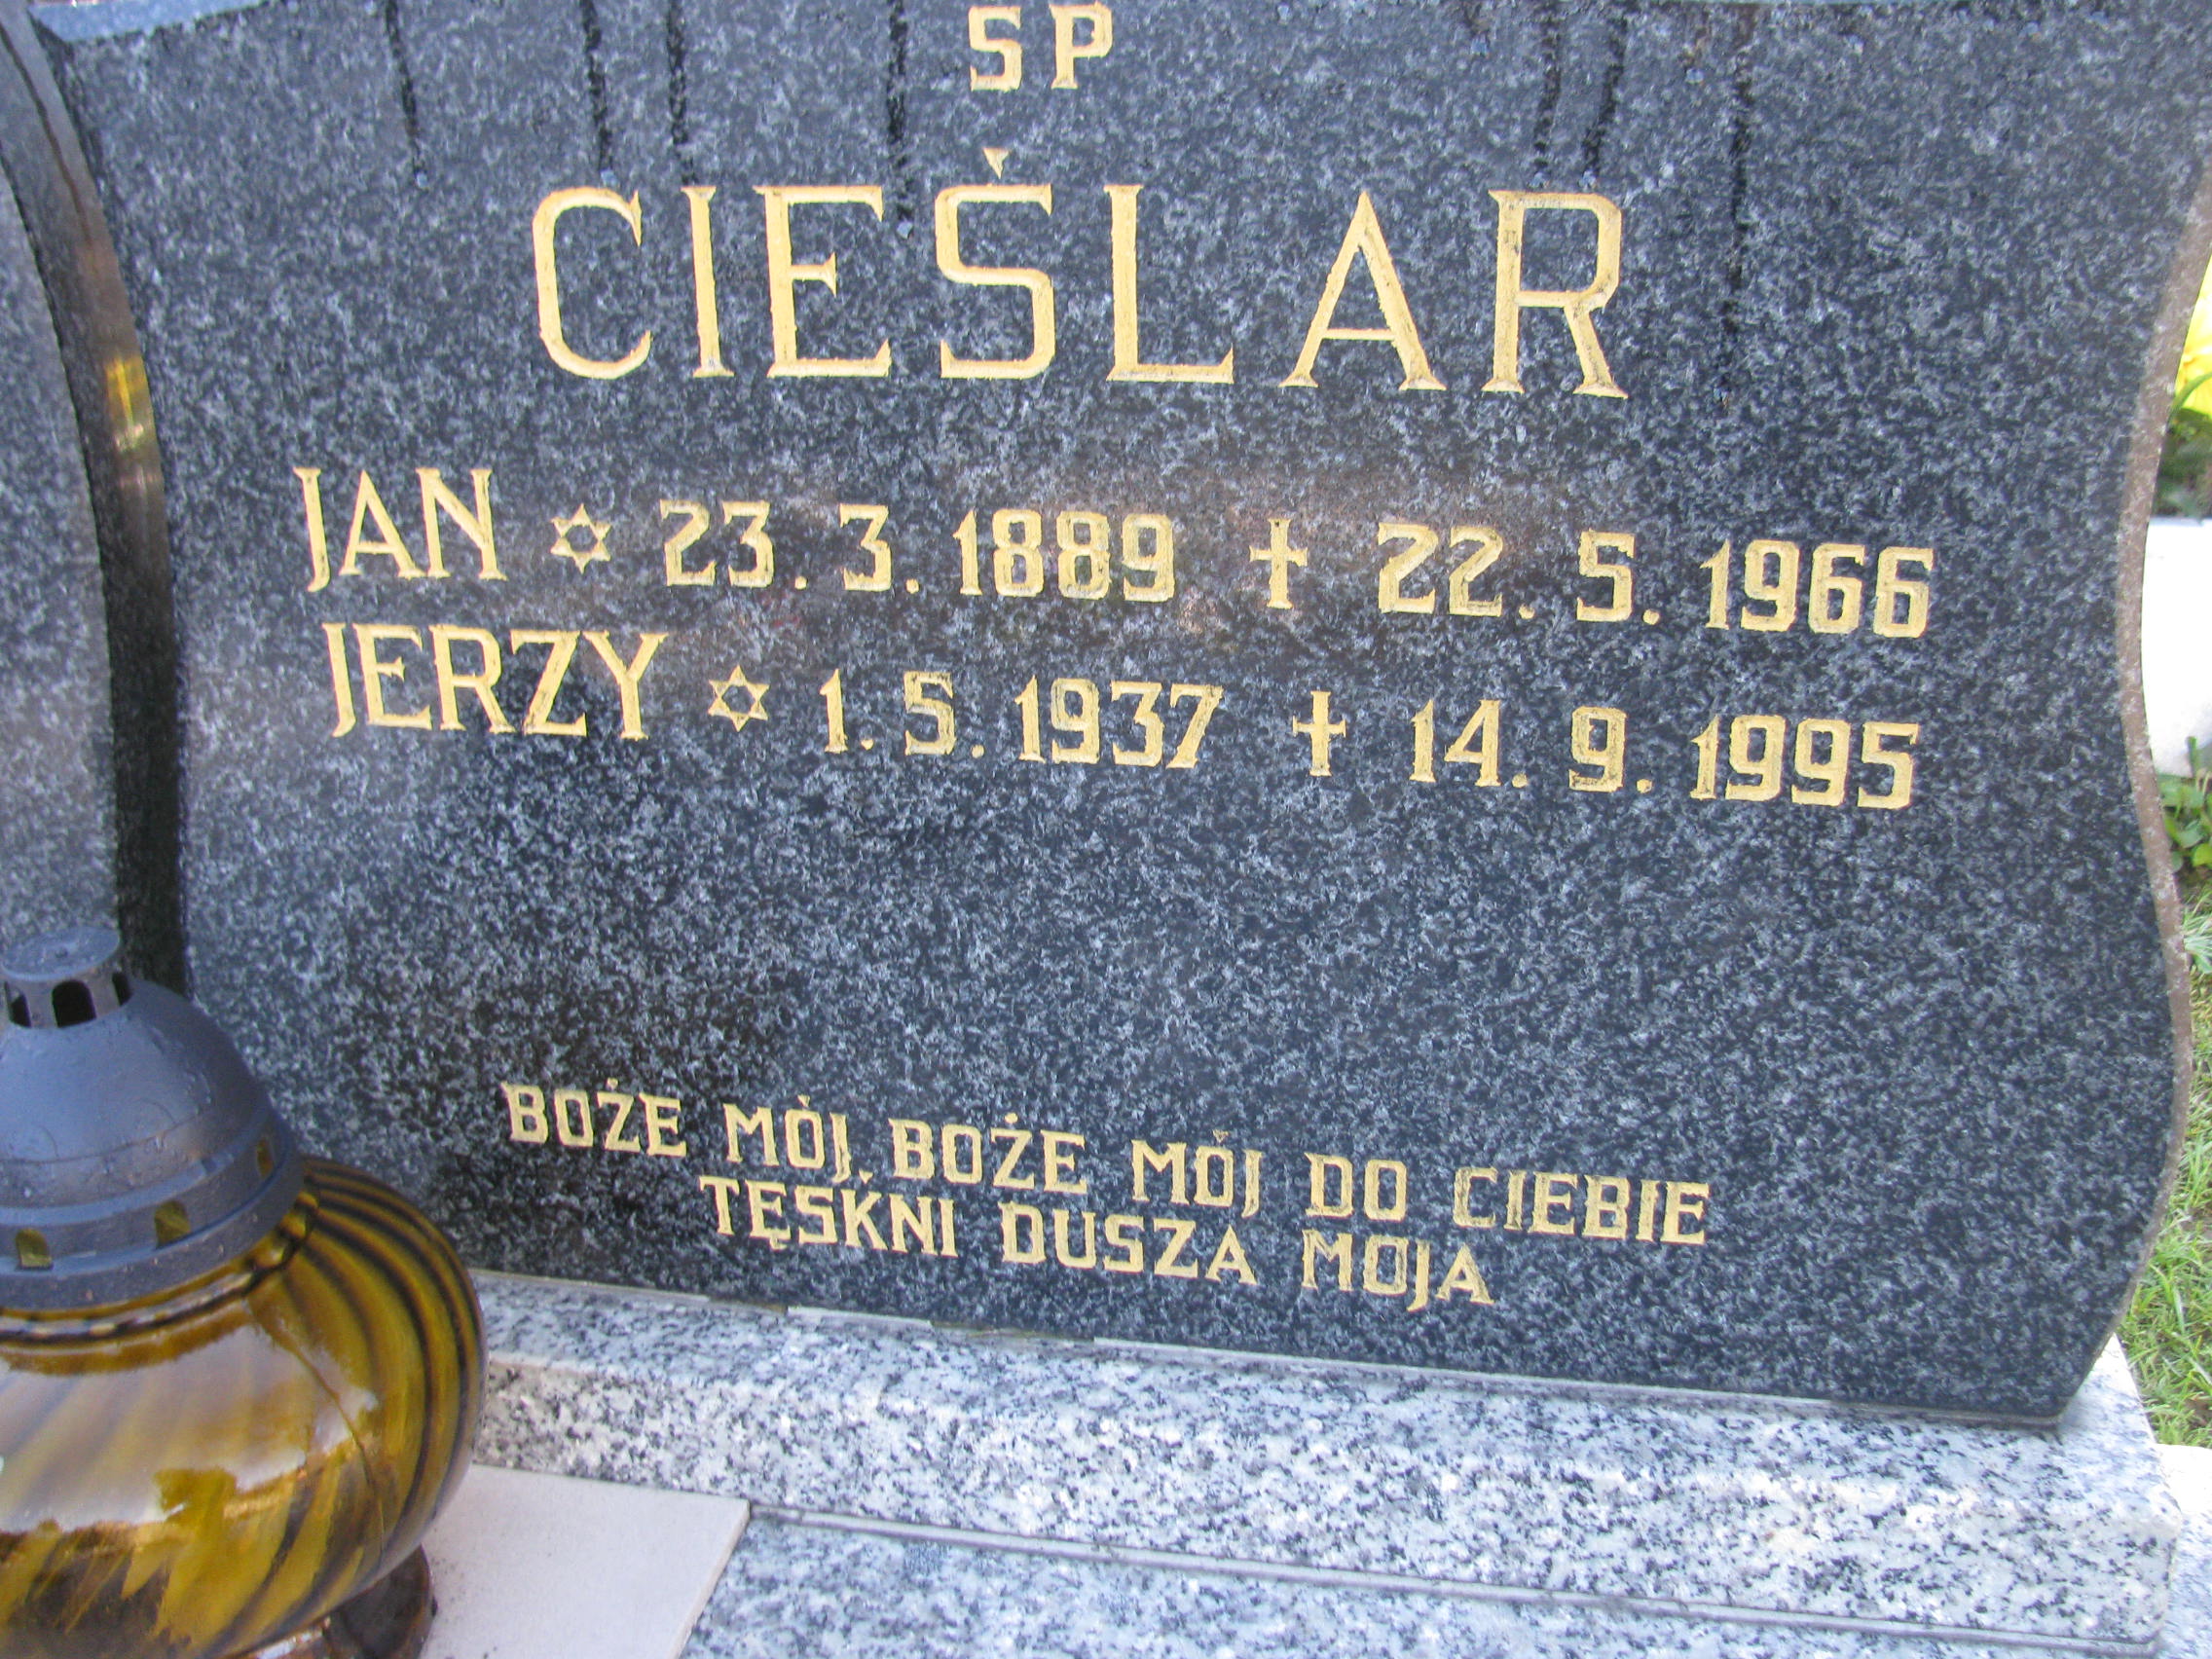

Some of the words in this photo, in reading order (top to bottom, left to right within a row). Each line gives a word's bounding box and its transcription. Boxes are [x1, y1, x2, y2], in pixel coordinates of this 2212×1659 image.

[532, 146, 1629, 399] CIEŚLAR
[293, 466, 507, 593] JAN
[659, 498, 808, 590] 23.
[838, 503, 921, 592] 3.
[952, 508, 1177, 604] 1889
[1372, 518, 1535, 620] 22.
[1576, 528, 1660, 626] 5.
[1699, 538, 1935, 639] 1966
[321, 622, 669, 742] JERZY
[819, 669, 875, 754] 1.
[903, 670, 985, 757] 5.
[1014, 677, 1224, 769] 1937
[1410, 699, 1529, 789] 14.
[1568, 705, 1653, 793] 9.
[1689, 714, 1921, 810] 1995
[501, 1078, 687, 1158] BOŻE
[888, 1112, 1088, 1195] BOŻE
[1132, 1129, 1263, 1219] MÓJ
[1305, 1152, 1408, 1222] DO
[1453, 1166, 1712, 1246] CIEBIE
[698, 1175, 958, 1259] TĘSKNI
[998, 1201, 1257, 1285] DUSZA
[1301, 1229, 1494, 1312] MOJA
